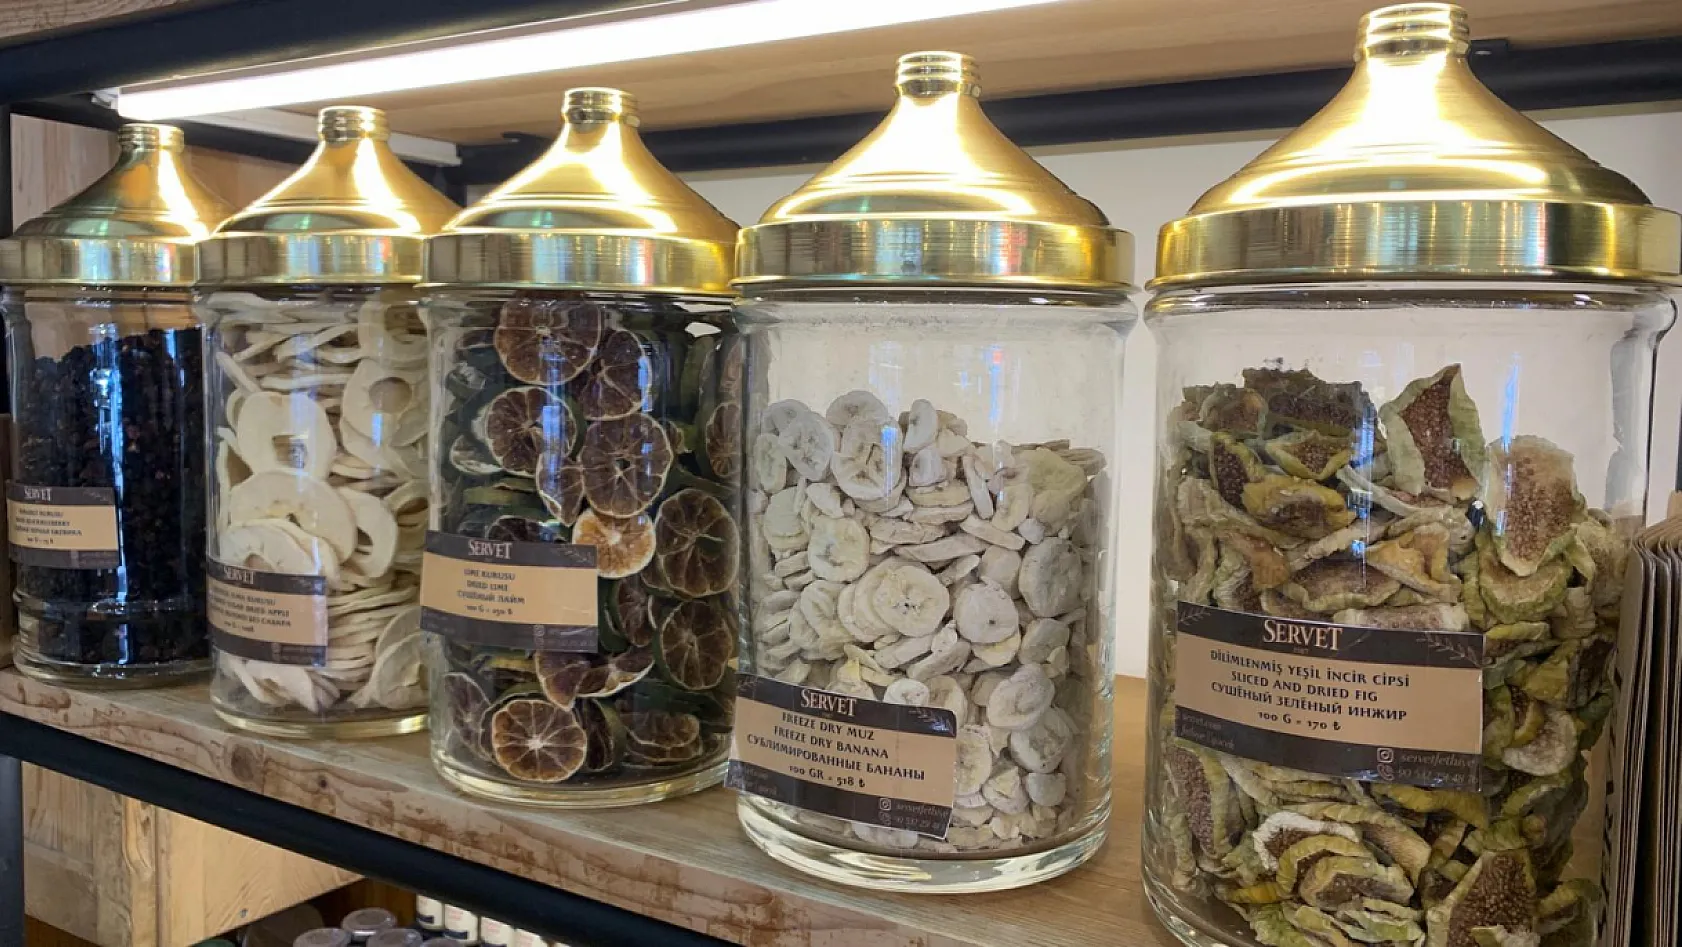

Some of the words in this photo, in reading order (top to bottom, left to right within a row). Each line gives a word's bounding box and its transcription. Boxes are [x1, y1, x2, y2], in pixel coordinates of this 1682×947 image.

[468, 539, 513, 560] SERVET
[1262, 619, 1344, 650] SERVET
[1210, 649, 1283, 675] DİLİMLENMİŞ
[1288, 664, 1321, 680] YEŞİL
[1326, 668, 1368, 684] İNCİR
[1372, 671, 1411, 688] CİPSİ
[1211, 681, 1273, 705] СУШЁНЫЙ
[1276, 695, 1343, 715] ЗЕЛЁНЫЙ
[1348, 706, 1408, 721] ИНЖИР
[1231, 670, 1269, 687] SLICED
[1273, 679, 1302, 693] AND
[1307, 685, 1349, 699] DRIED
[1355, 690, 1378, 702] FIG
[800, 688, 858, 717] SERVET
[782, 711, 816, 730] FREEZE
[820, 721, 843, 734] DRY
[847, 727, 875, 741] MUZ
[1257, 711, 1279, 722] 100
[1283, 713, 1292, 724] G
[1307, 720, 1328, 731] 170
[746, 733, 862, 771] СУБЛИМИРОВАННЫЕ
[866, 762, 925, 781] БАНАНЫ
[774, 725, 806, 743] FREEZE
[810, 735, 834, 749] DRY
[836, 740, 889, 759] BANANA
[789, 765, 806, 775] 100
[808, 768, 824, 780] GR
[836, 776, 855, 786] 518
